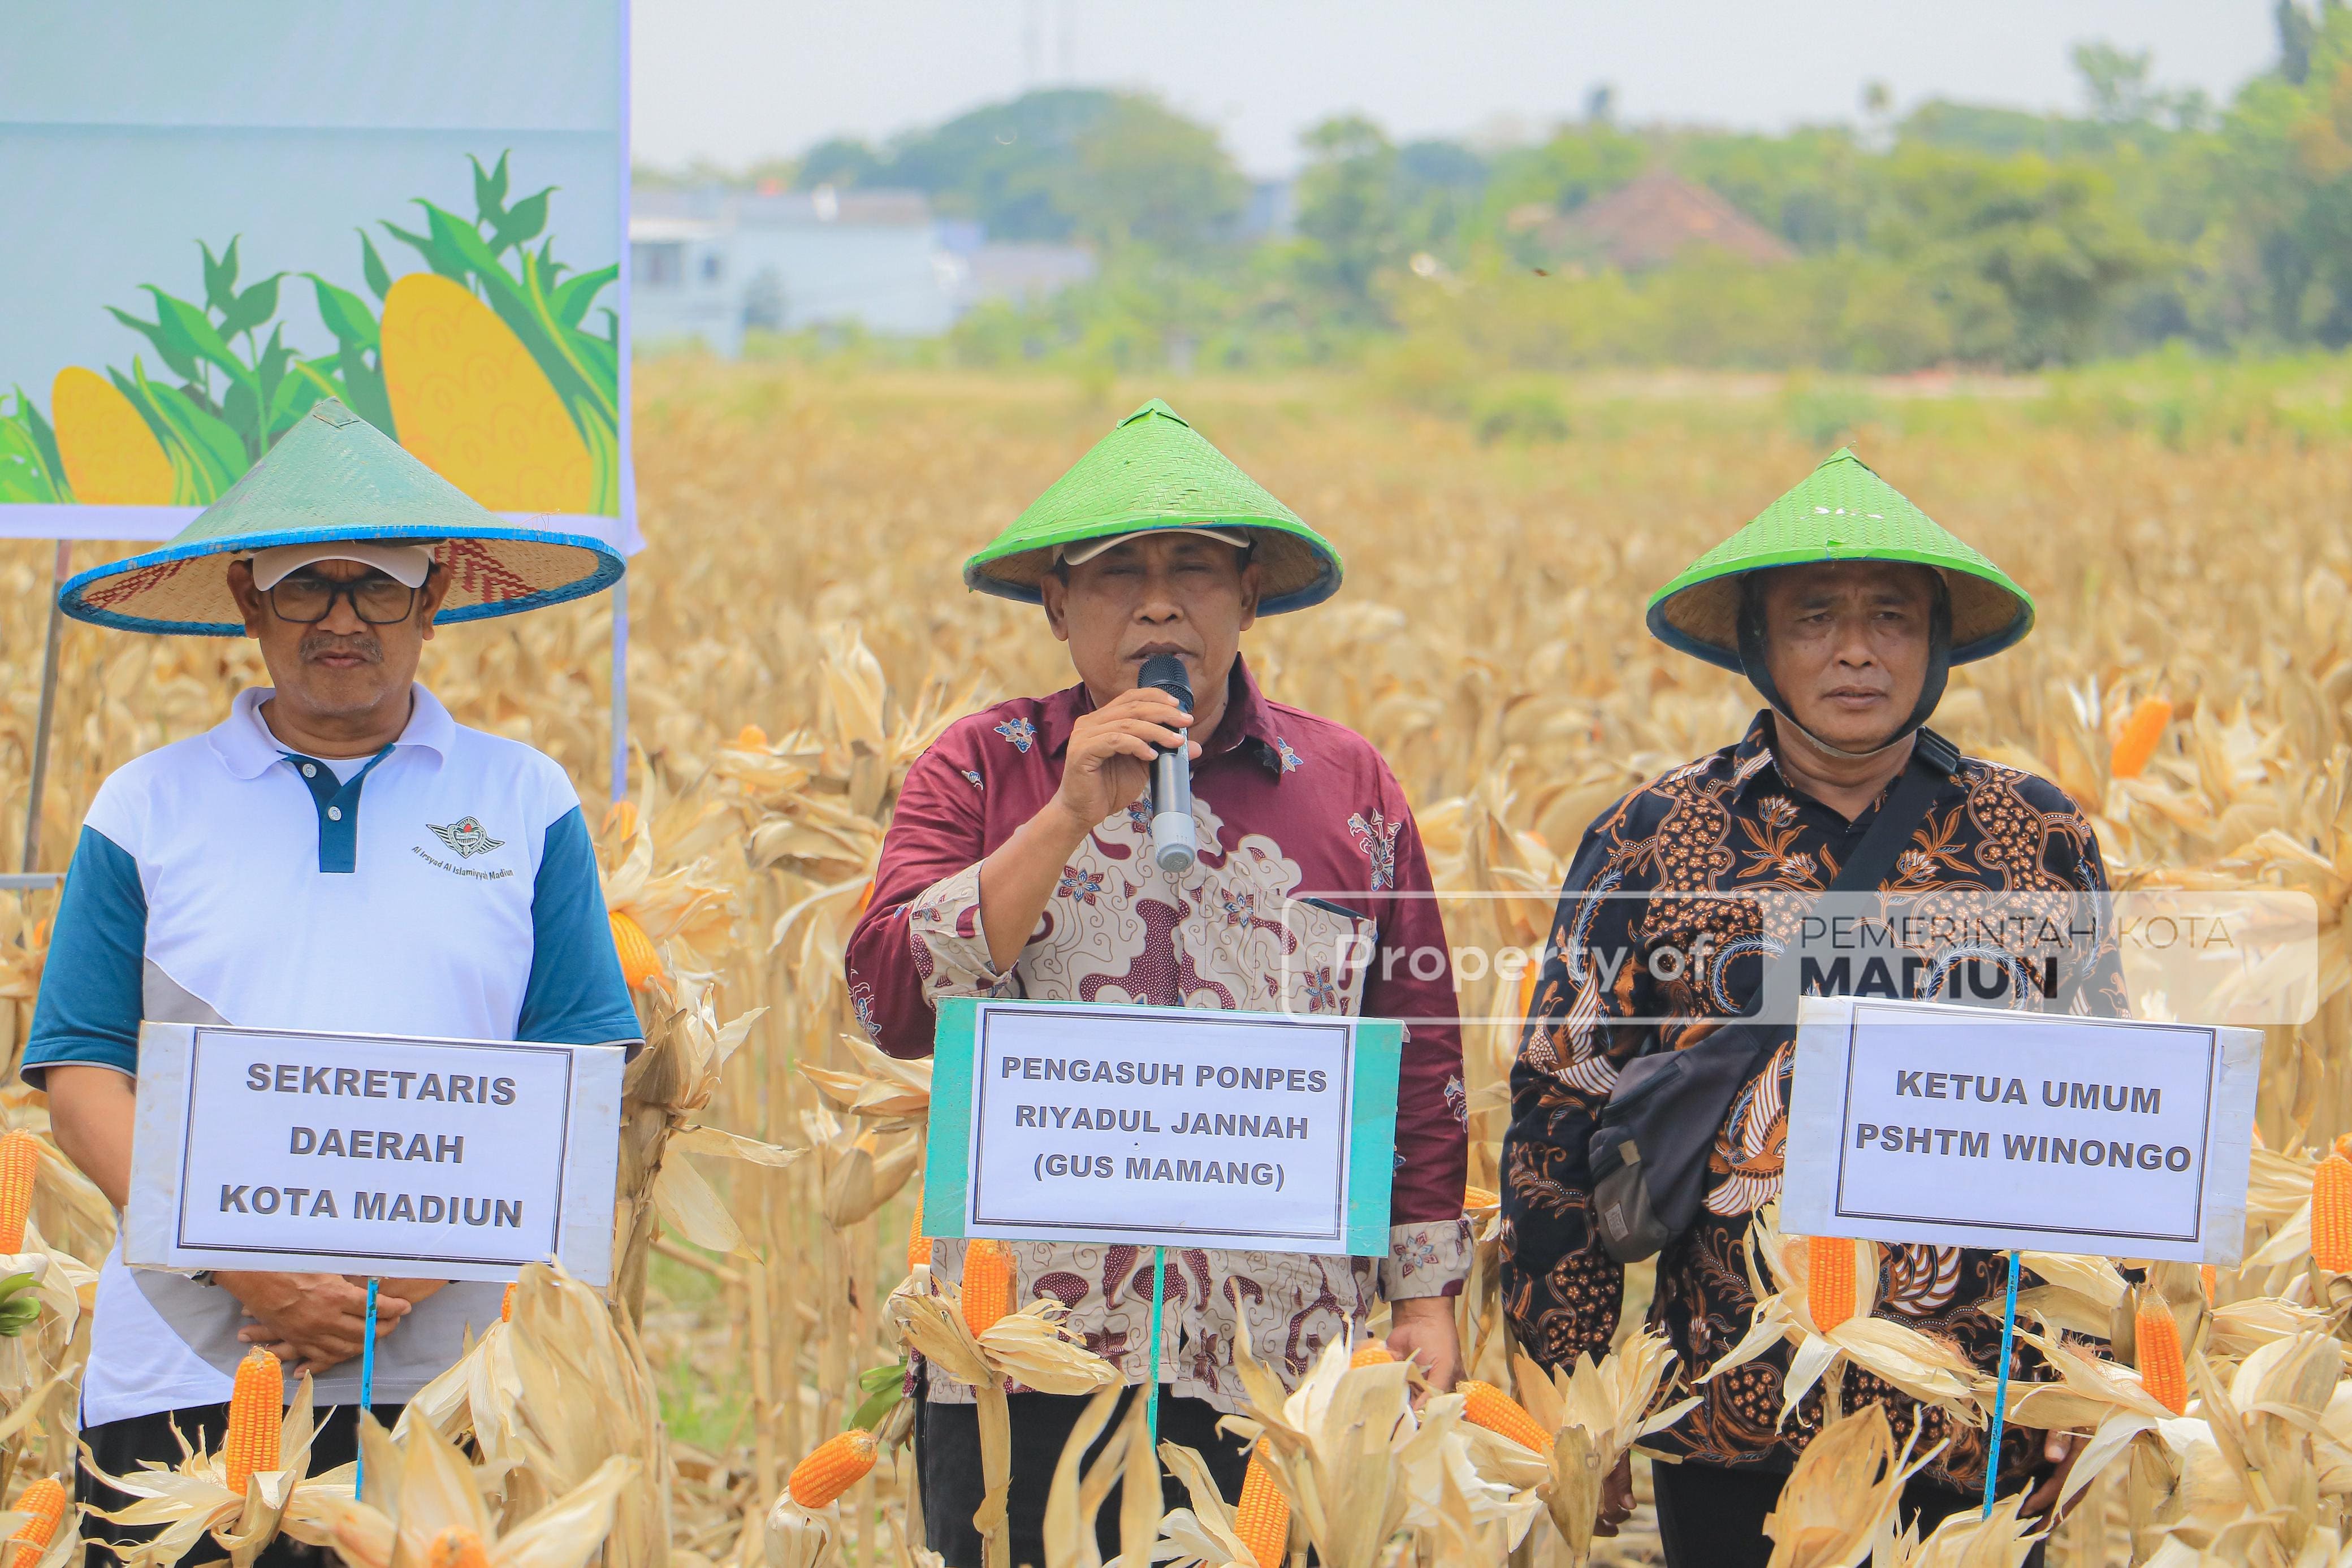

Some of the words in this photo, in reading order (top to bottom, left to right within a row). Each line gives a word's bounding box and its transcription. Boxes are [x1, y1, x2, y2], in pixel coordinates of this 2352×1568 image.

[420, 851, 444, 868] Irsyad
[489, 869, 514, 880] Madiun
[246, 1063, 516, 1106] SEKRETARIS
[1002, 1056, 1183, 1086] PENGASUH
[1196, 1065, 1327, 1093] PONPES
[1896, 1070, 2028, 1105] KETUA
[2042, 1080, 2161, 1114] UMUM
[1015, 1104, 1160, 1133] RIYADUL
[1170, 1112, 1308, 1140] JANNAH
[289, 1127, 464, 1164] DAERAH
[1856, 1123, 1990, 1158] PSHTM
[2002, 1134, 2191, 1172] WINONGO
[1034, 1153, 1114, 1181] (GUS
[1125, 1157, 1285, 1192] MAMANG)
[219, 1184, 339, 1219] KOTA
[353, 1191, 523, 1228] MADIUN
